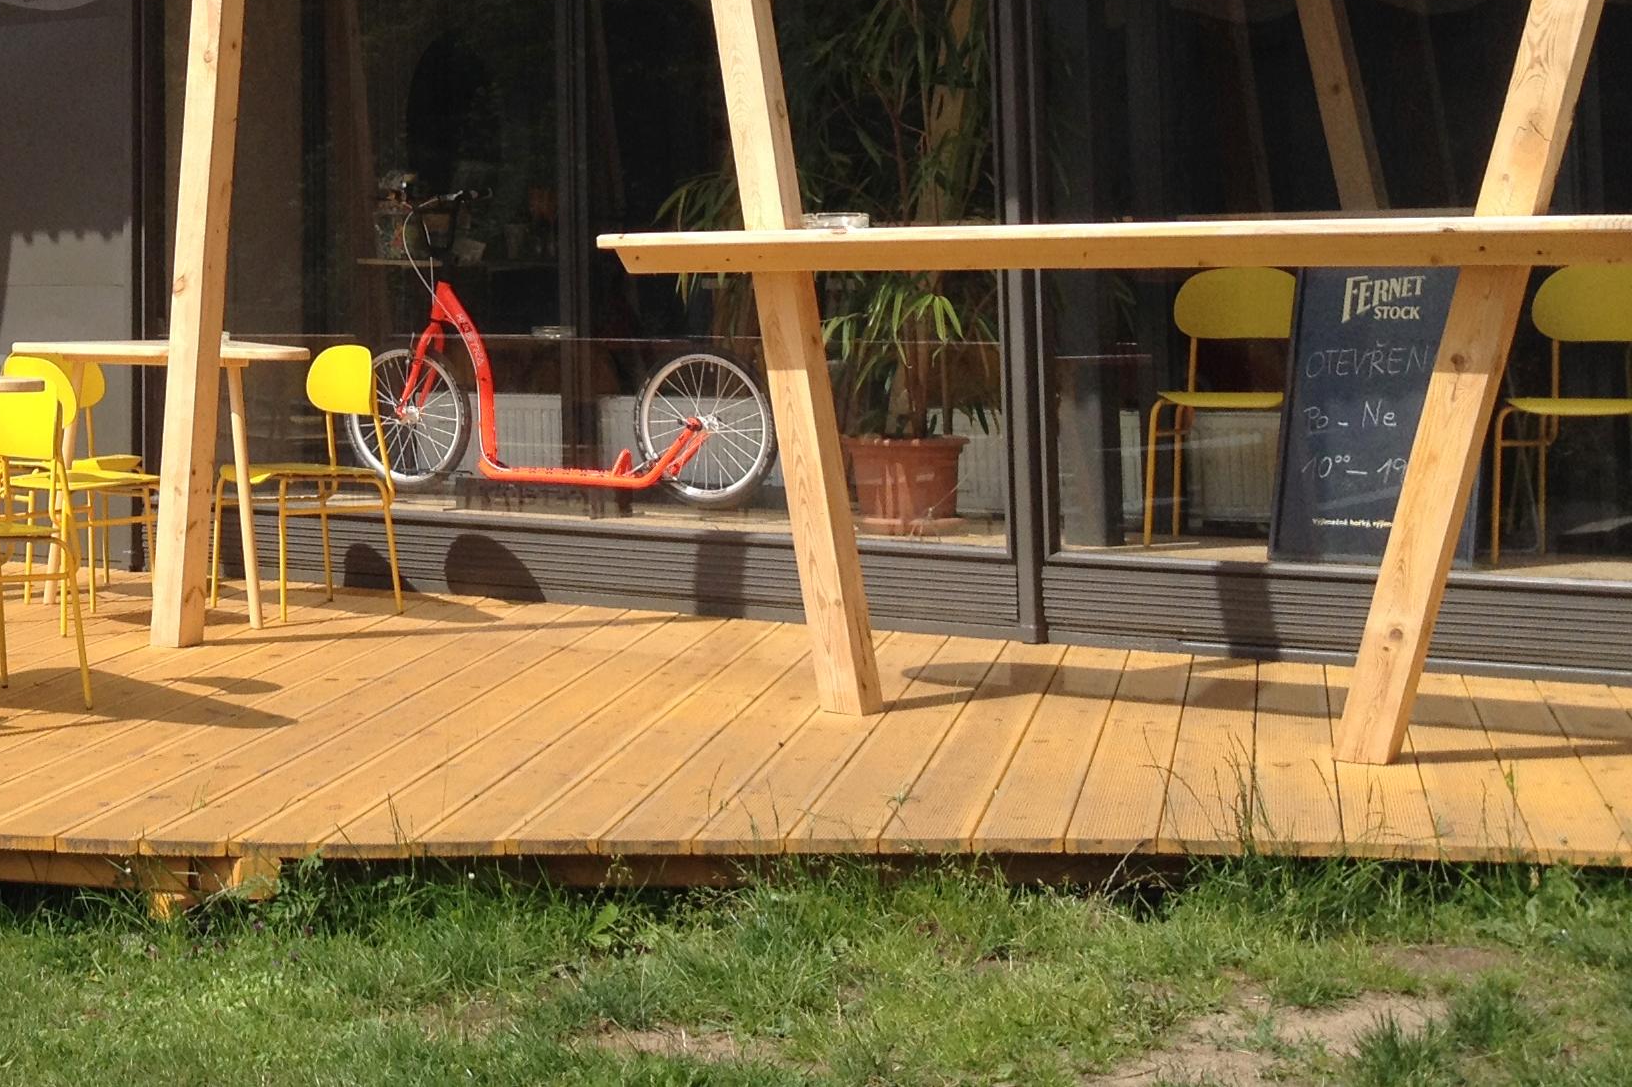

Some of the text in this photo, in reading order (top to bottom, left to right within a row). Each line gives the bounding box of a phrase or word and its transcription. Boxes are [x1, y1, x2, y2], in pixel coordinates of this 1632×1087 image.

[1341, 275, 1426, 324] FERNET
[1373, 306, 1420, 320] STOCK
[1361, 398, 1397, 428] Ne
